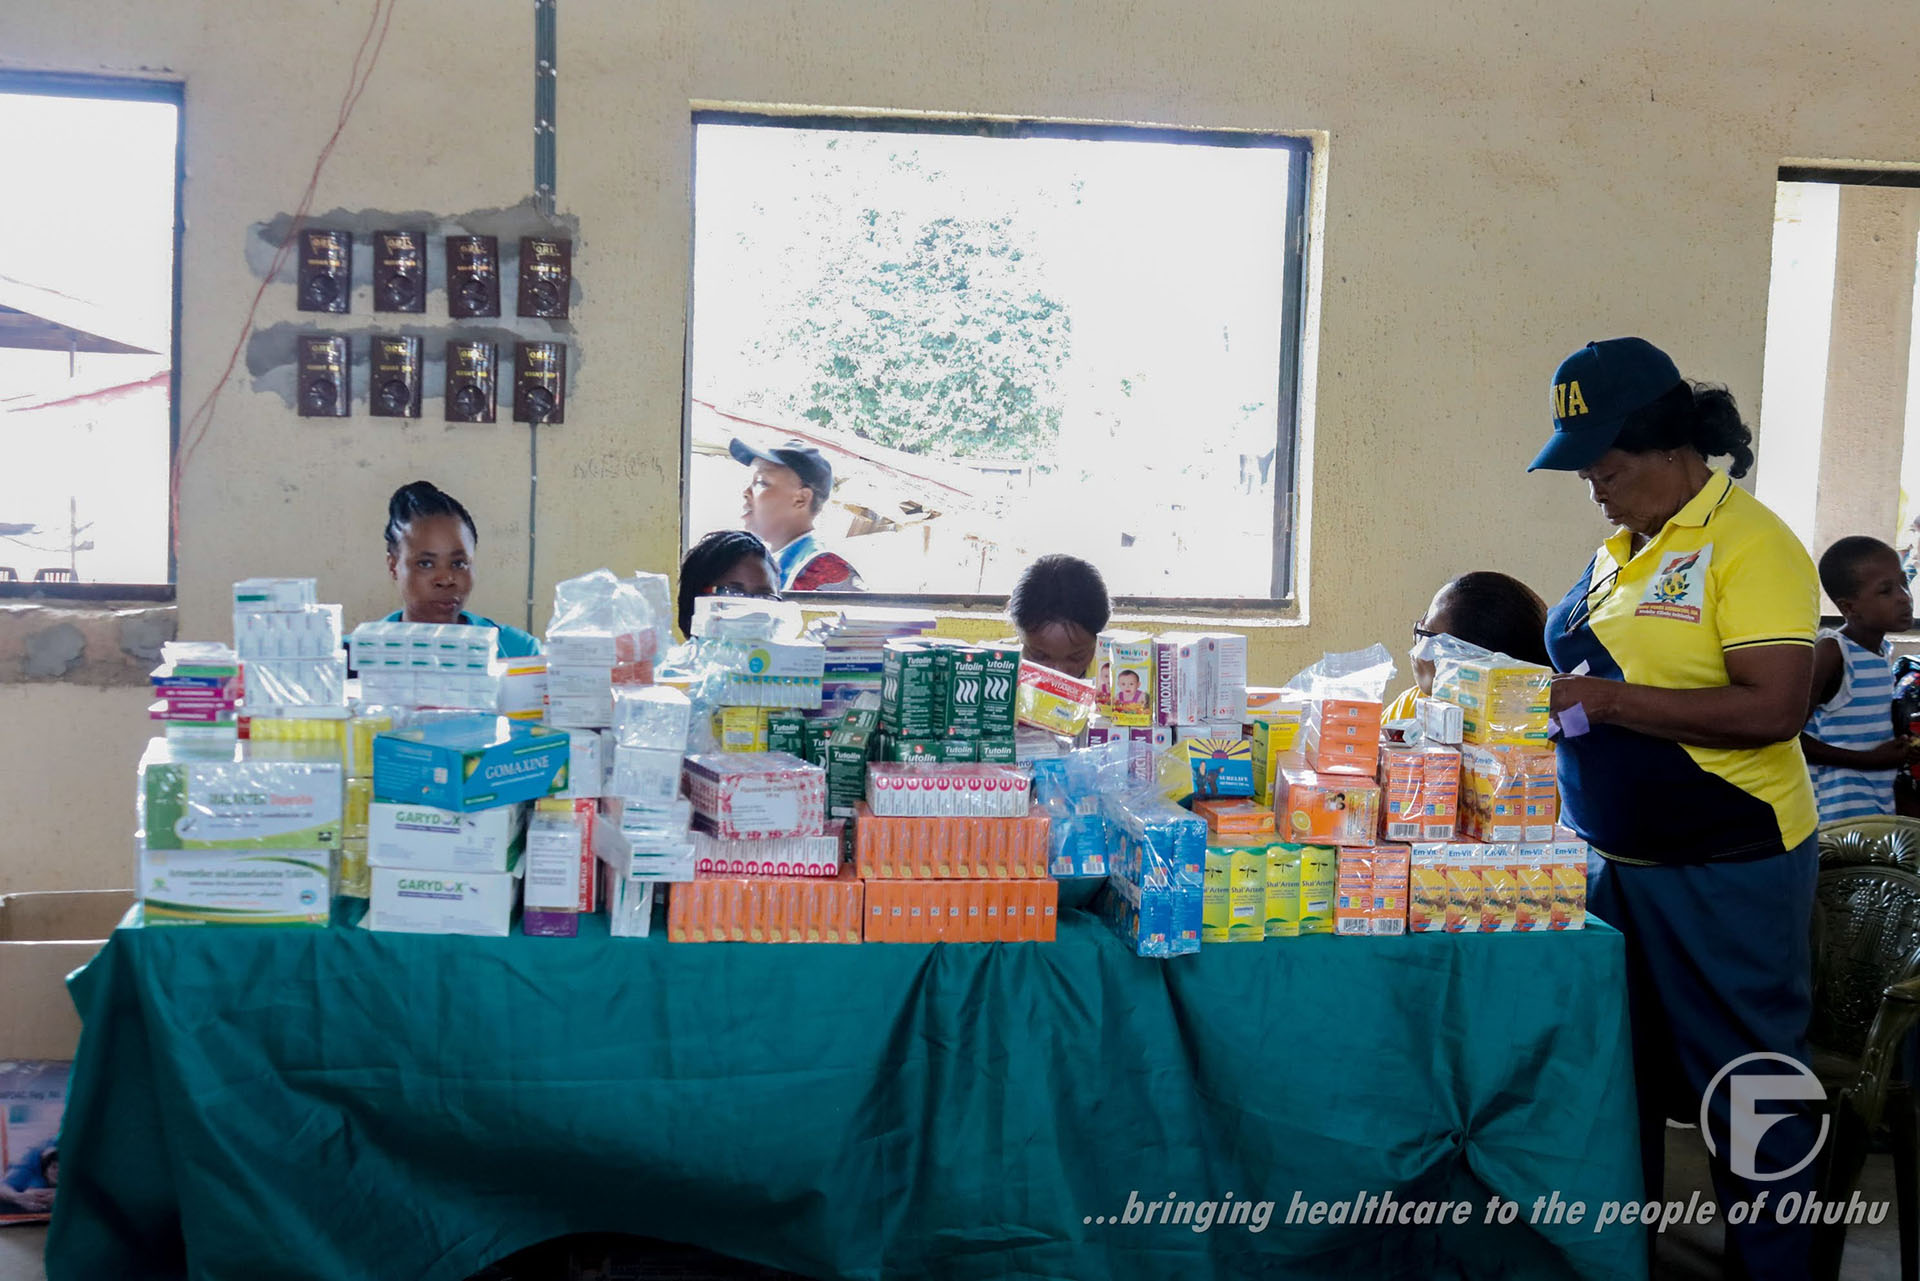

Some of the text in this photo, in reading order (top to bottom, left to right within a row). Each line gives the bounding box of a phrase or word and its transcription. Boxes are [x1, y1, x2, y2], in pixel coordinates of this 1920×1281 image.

[906, 656, 931, 667] Tutolin
[955, 661, 984, 671] Tutolin
[986, 659, 1015, 670] utolin
[1160, 650, 1171, 714] AMOXICILLIN
[945, 746, 972, 754] Tutolin
[984, 747, 1012, 755] Tutolin
[833, 751, 860, 760] Tutolin
[485, 755, 549, 779] GOMAXINE
[395, 811, 461, 826] GARYDOX
[1520, 847, 1550, 856] Em-Vit-C
[1555, 846, 1585, 855] Em-Vit-C
[397, 879, 463, 893] GARYDOX
